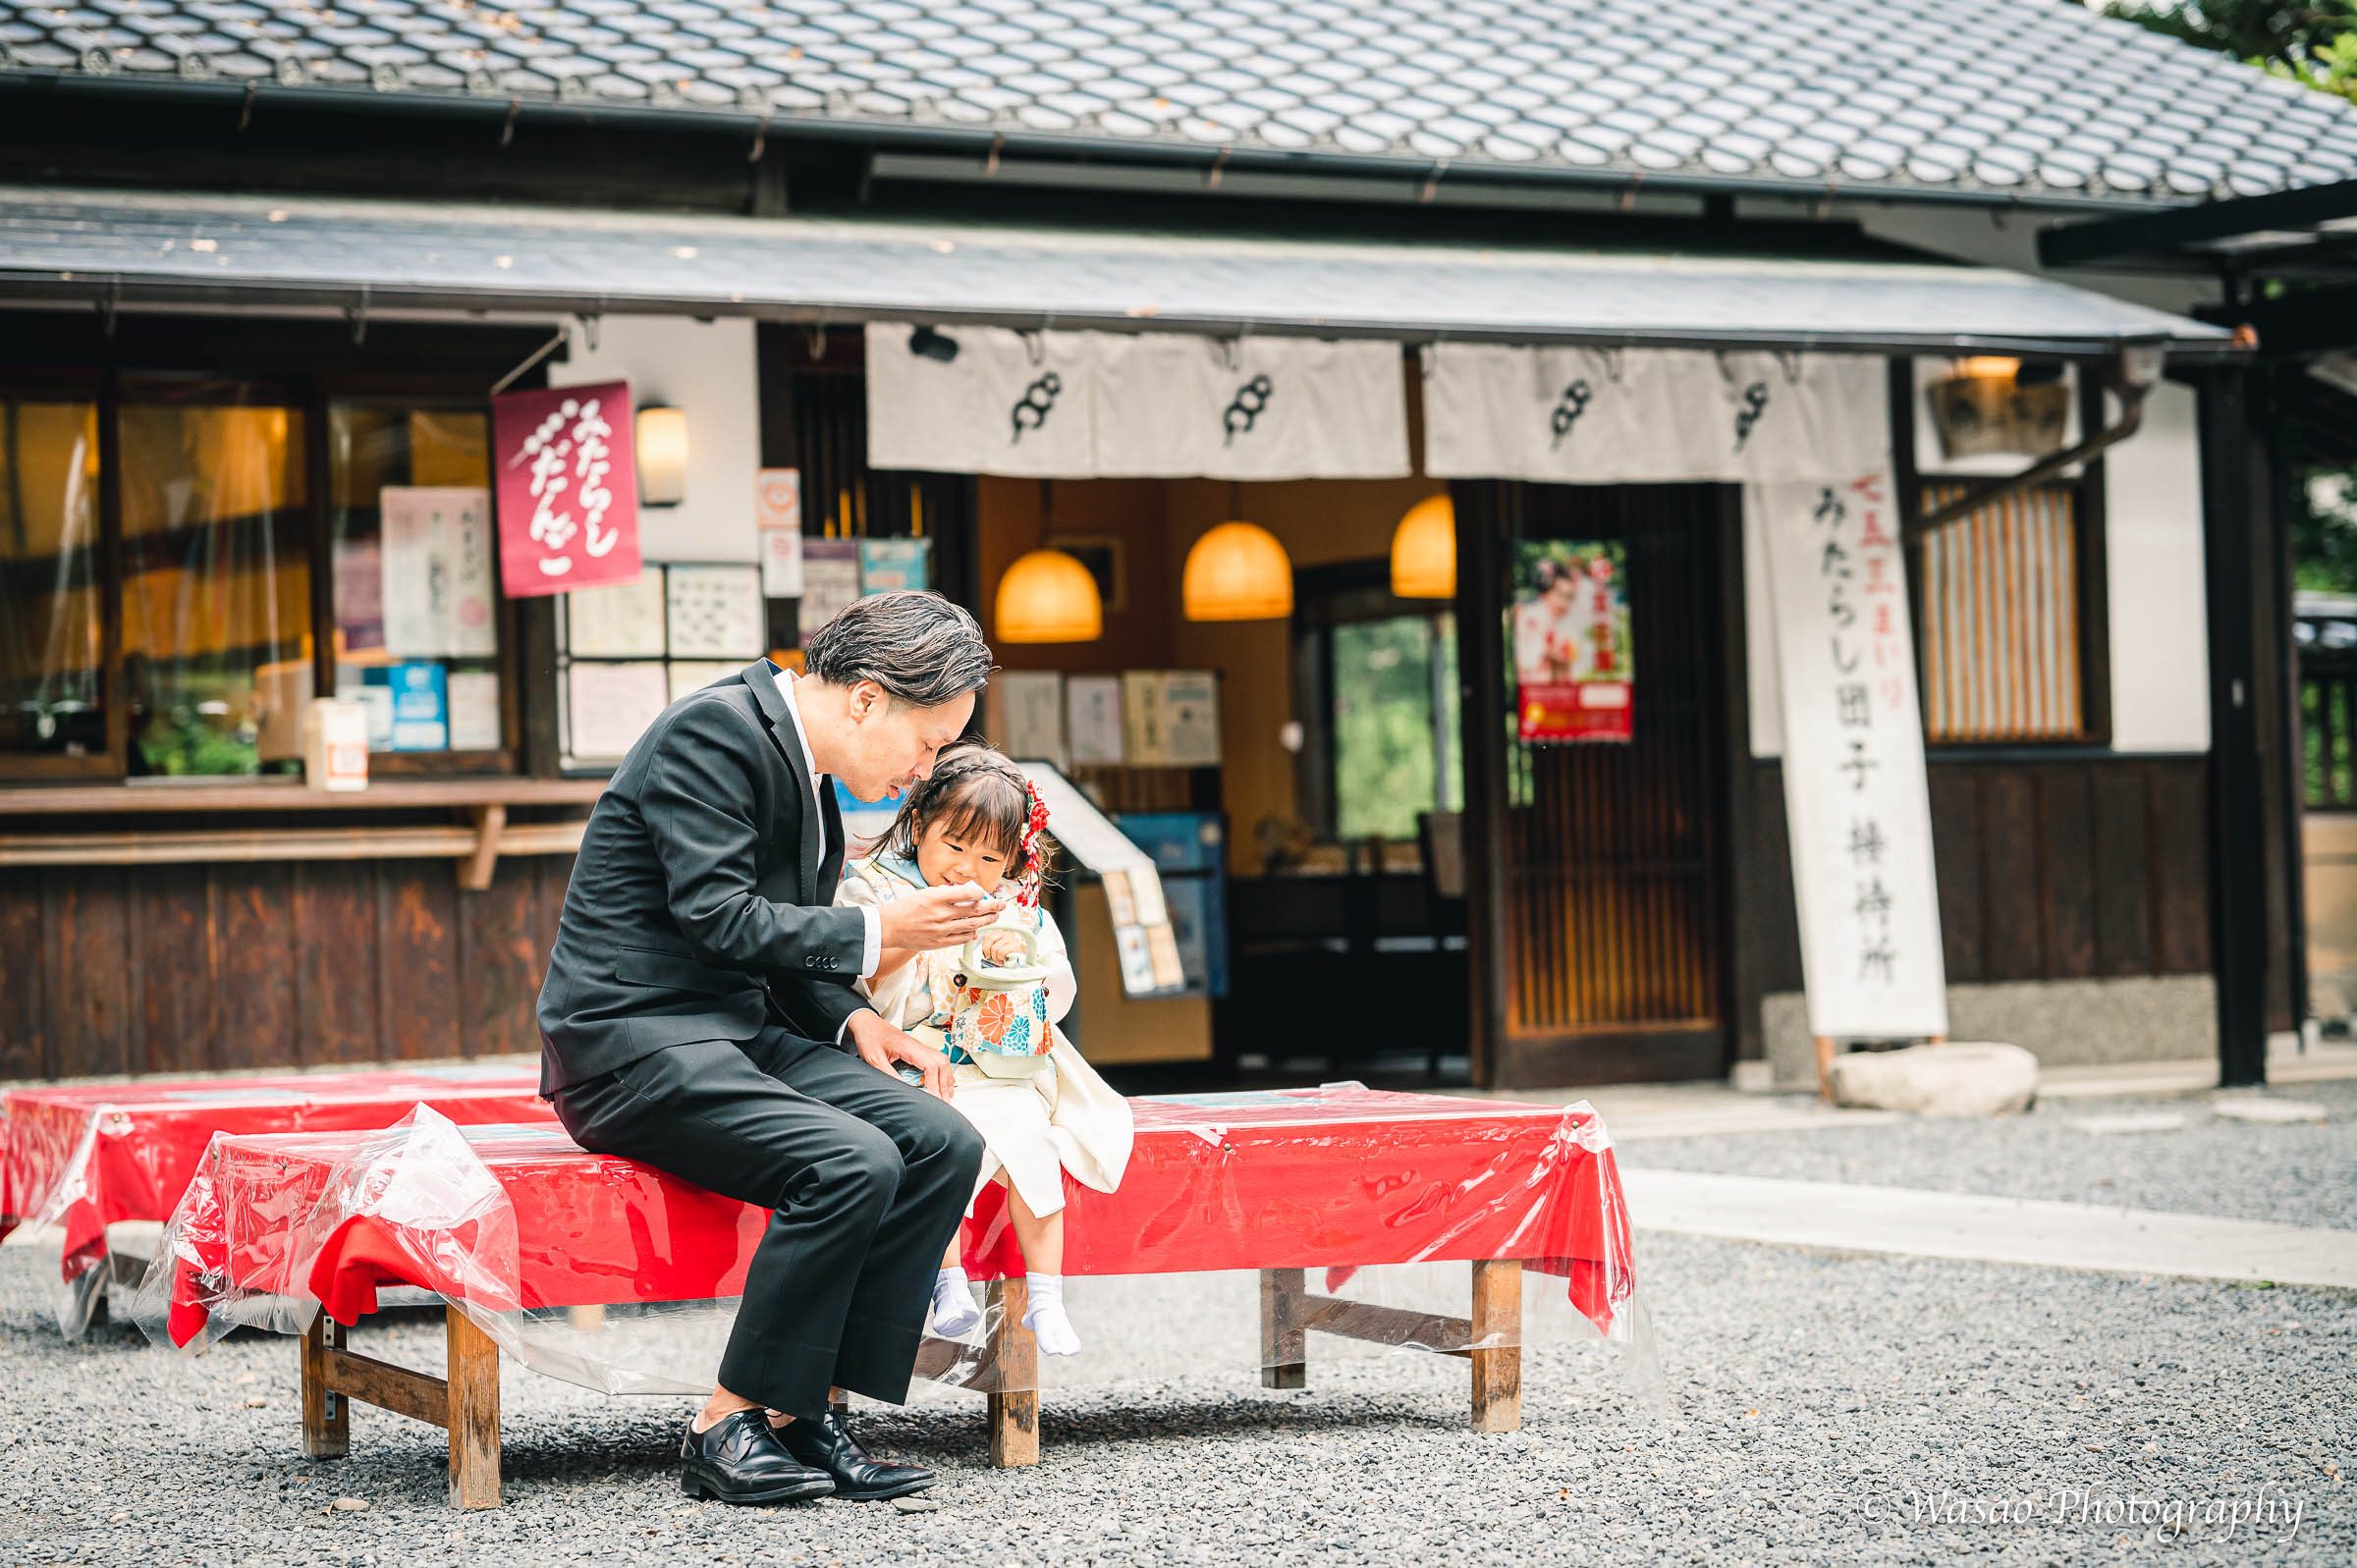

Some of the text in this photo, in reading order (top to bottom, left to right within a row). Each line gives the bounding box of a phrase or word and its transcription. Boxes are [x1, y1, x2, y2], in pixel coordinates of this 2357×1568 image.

[528, 438, 578, 576] だんご
[573, 399, 619, 558] みたらし
